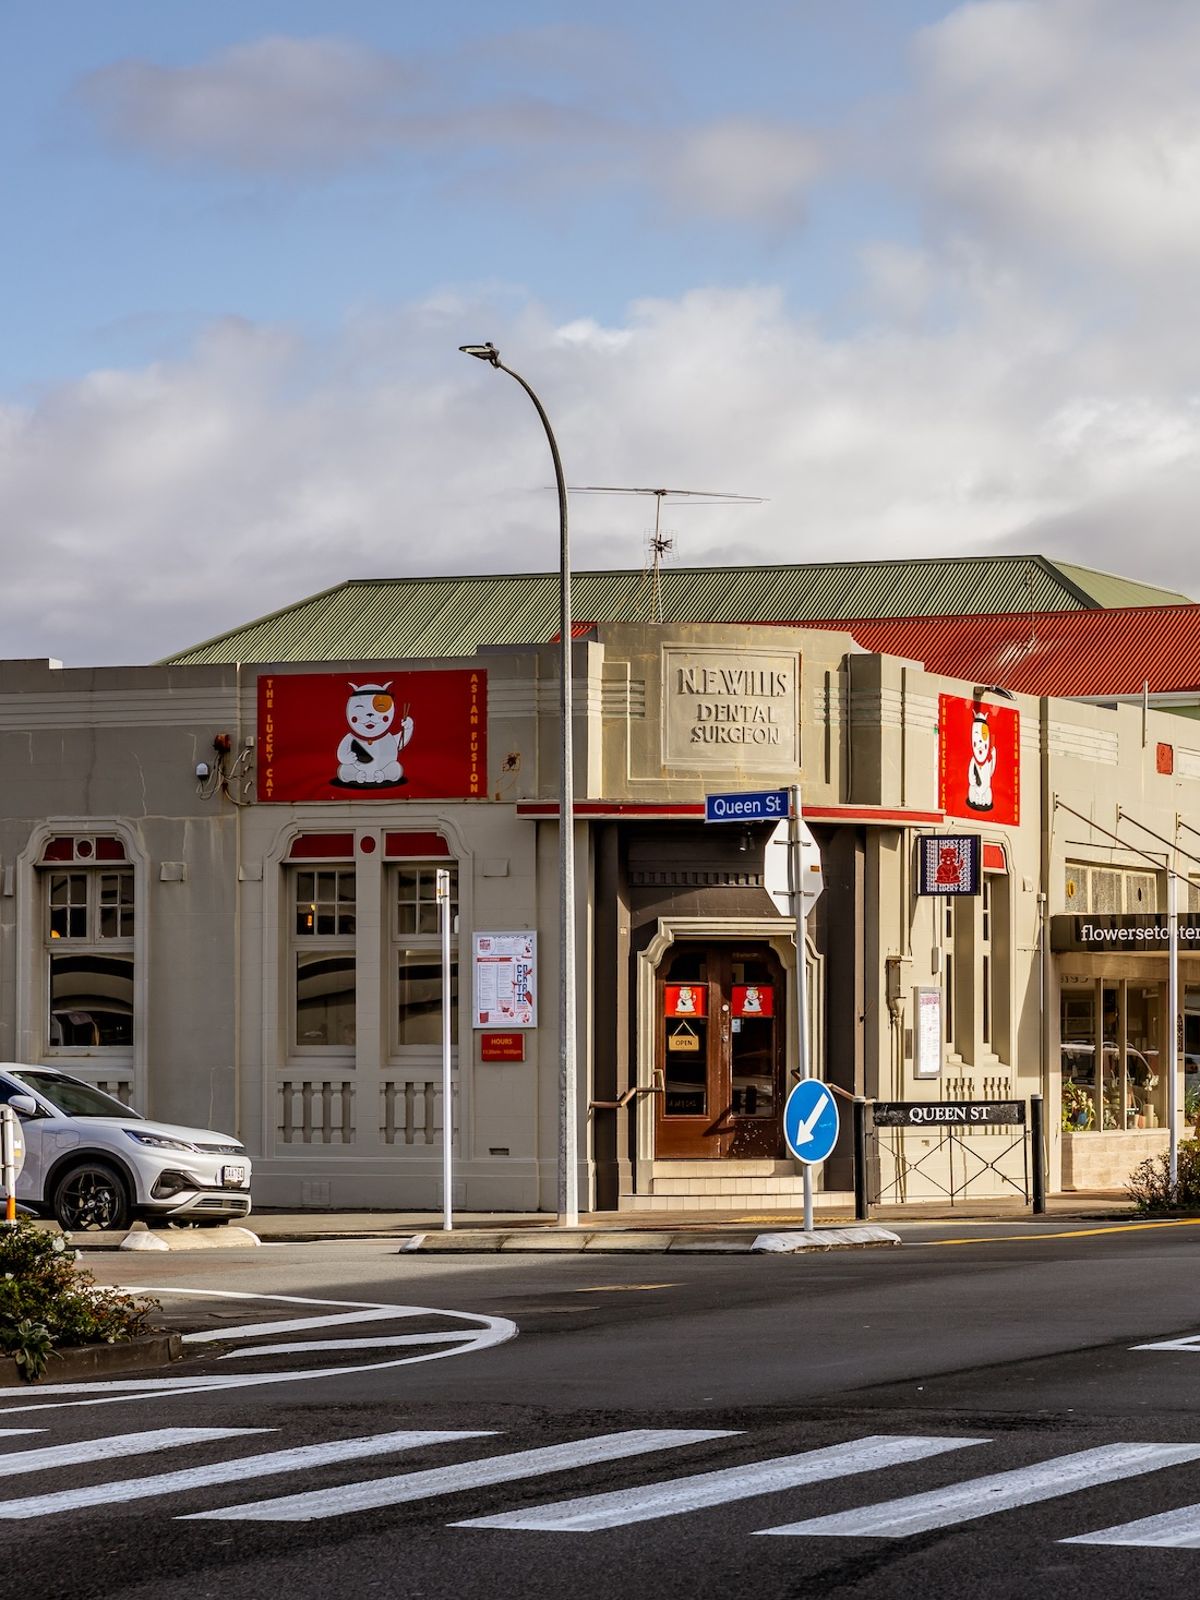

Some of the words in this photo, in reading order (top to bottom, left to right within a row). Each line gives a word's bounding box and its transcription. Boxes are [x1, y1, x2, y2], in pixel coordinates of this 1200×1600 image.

[265, 679, 274, 708] THE
[469, 673, 479, 725] ASIAN
[697, 703, 778, 724] DENTAL
[265, 714, 274, 763] LUCKY
[690, 725, 781, 745] SURGEON
[469, 732, 479, 793] FUSION
[265, 768, 274, 797] CAT
[714, 799, 761, 816] Queen
[765, 796, 782, 812] St
[909, 1107, 967, 1122] QUEEN
[970, 1106, 991, 1120] ST
